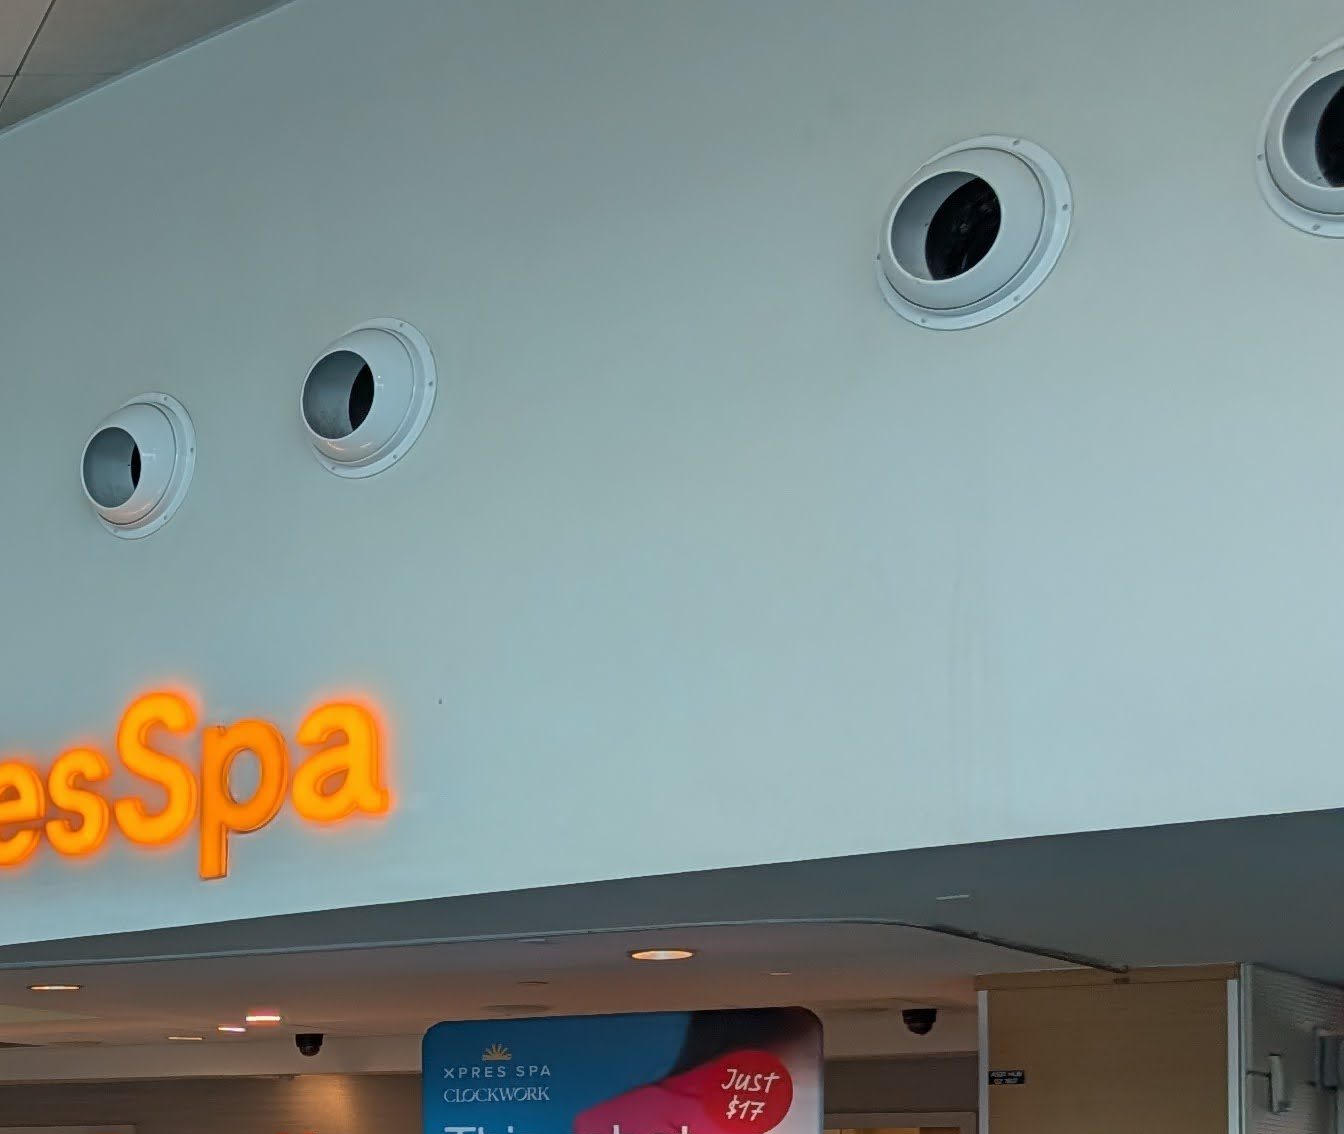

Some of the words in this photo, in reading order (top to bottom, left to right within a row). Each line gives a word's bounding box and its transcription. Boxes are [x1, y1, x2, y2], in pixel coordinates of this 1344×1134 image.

[443, 1066, 506, 1079] XPRES
[516, 1065, 551, 1078] SPA
[443, 1086, 551, 1103] CLOCKWORK
[725, 1094, 766, 1121] $17
